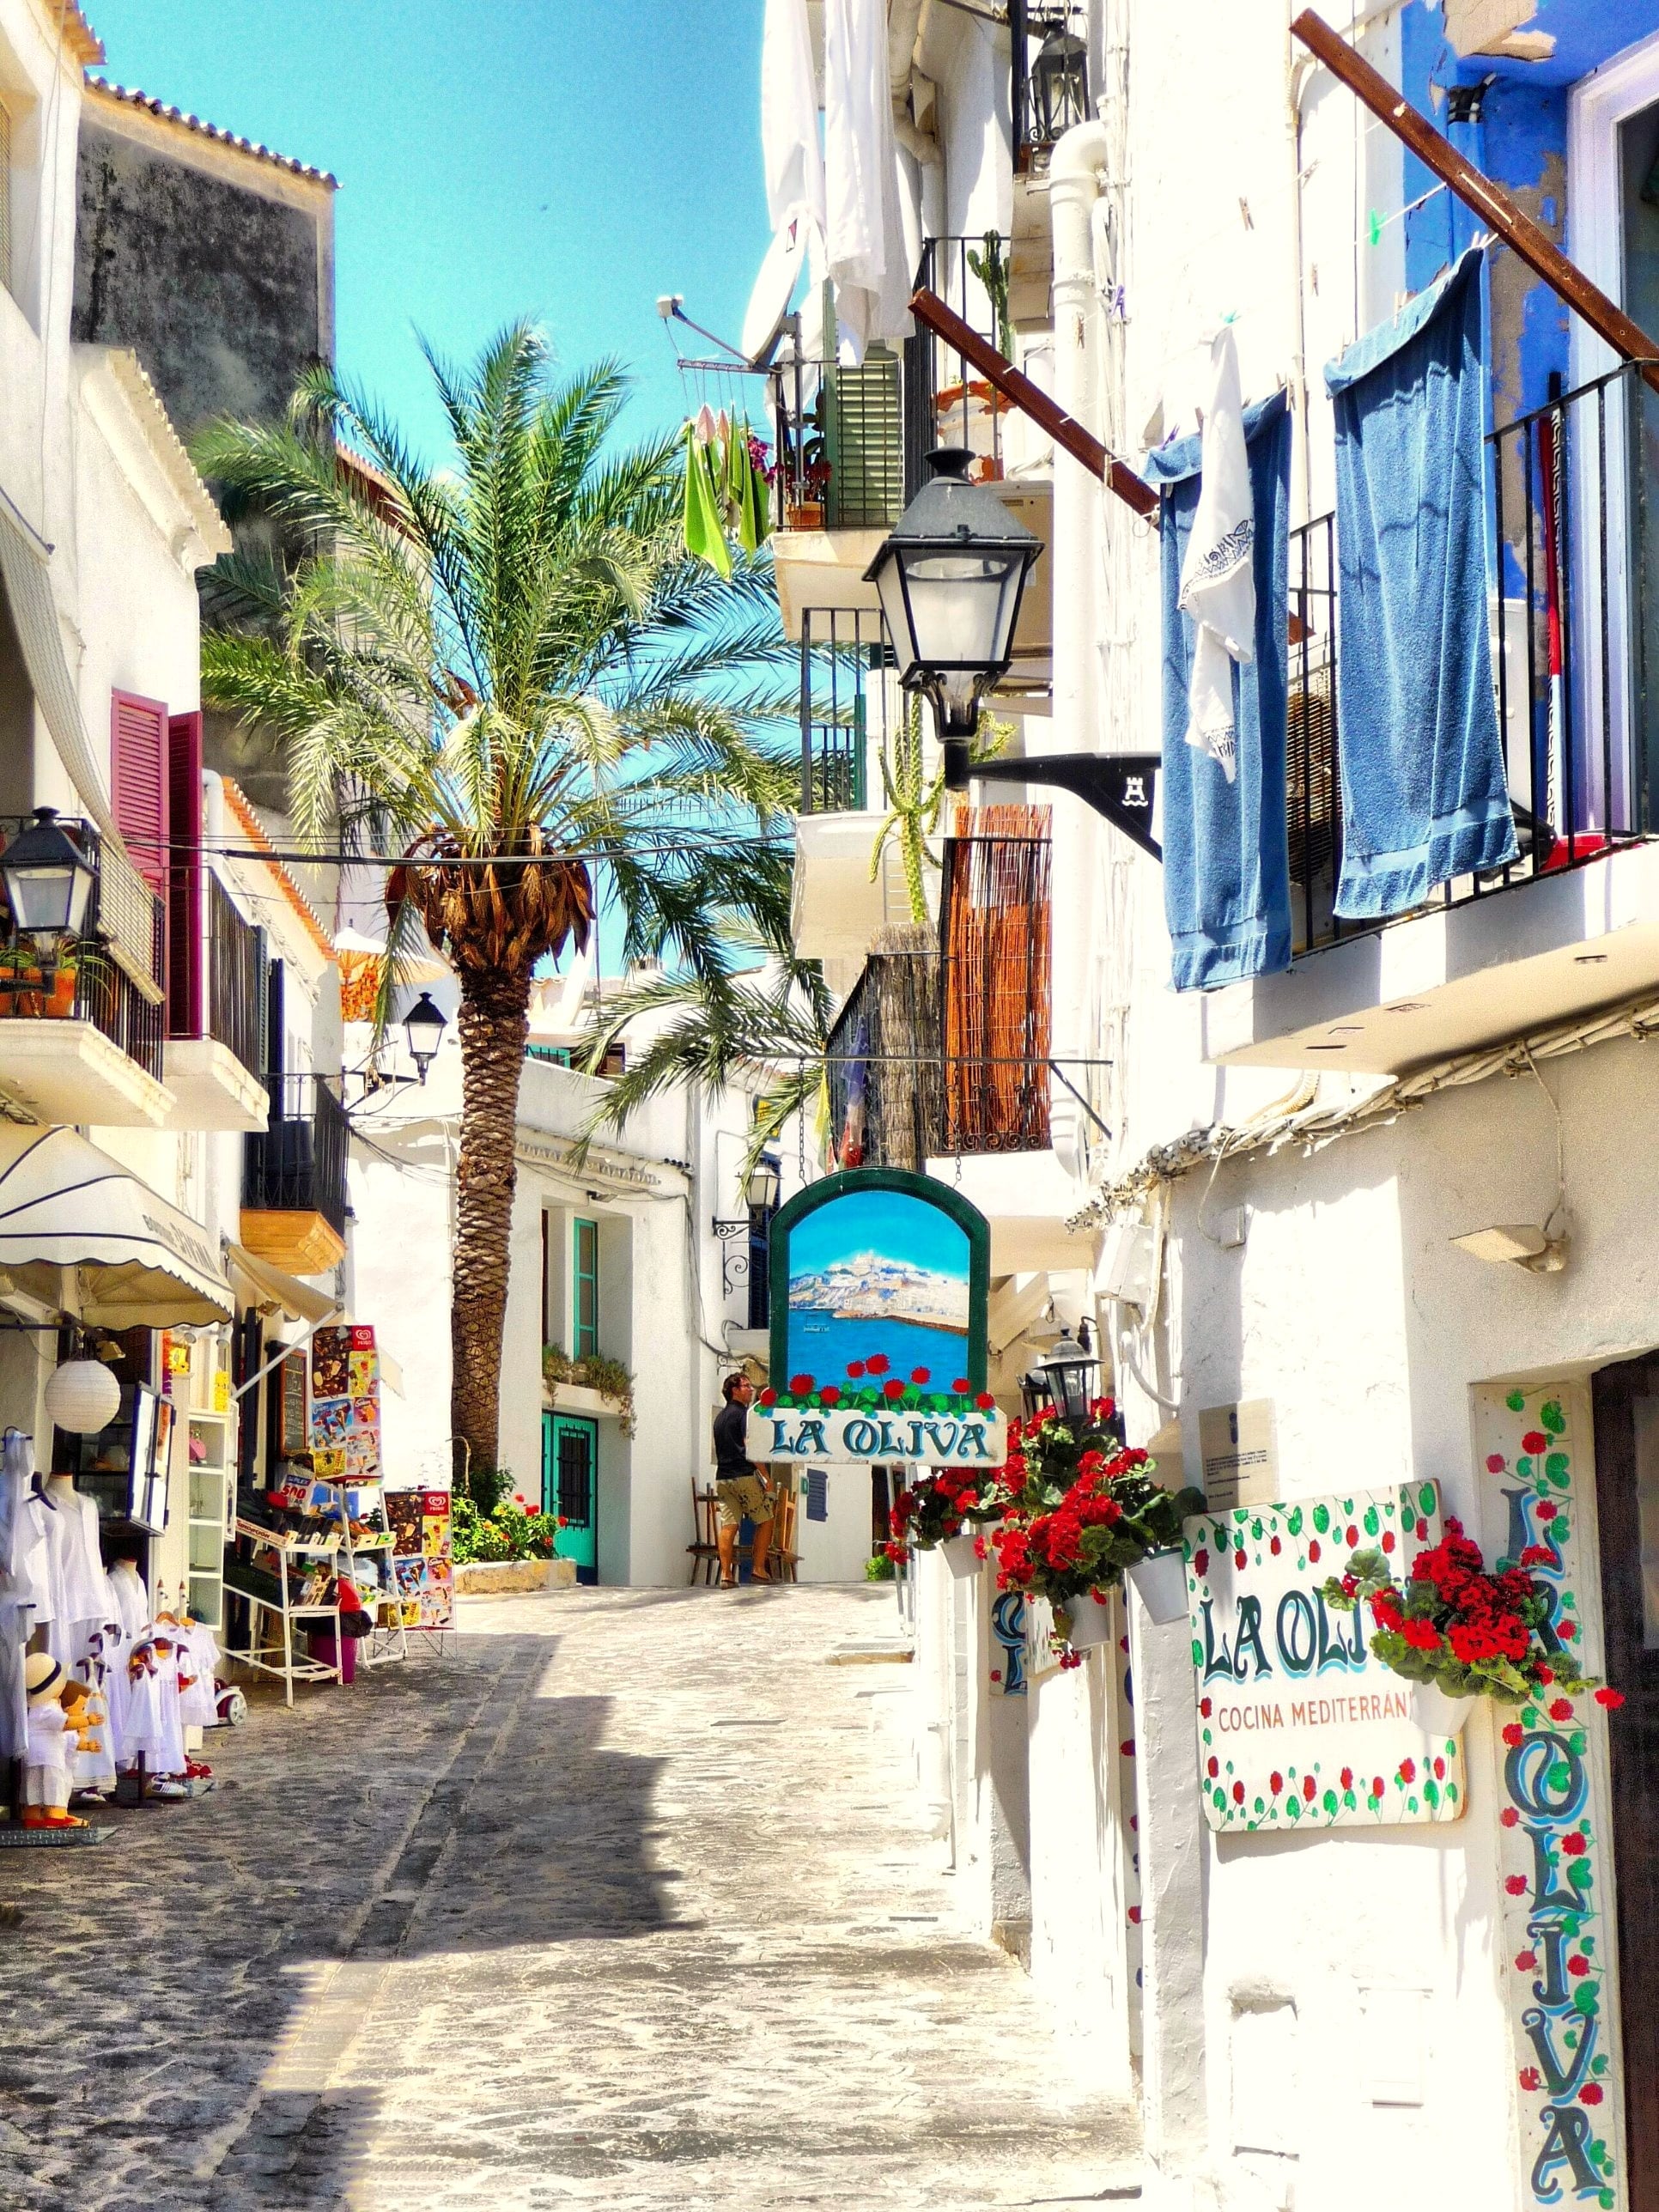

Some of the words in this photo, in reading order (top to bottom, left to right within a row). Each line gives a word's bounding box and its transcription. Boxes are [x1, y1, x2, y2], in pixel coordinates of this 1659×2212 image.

[769, 1419, 829, 1456] LA
[842, 1420, 990, 1458] OLIVA
[1200, 1595, 1273, 1686] LA
[1218, 1703, 1285, 1732] COCINA
[1504, 1730, 1604, 2201] OLIVA
